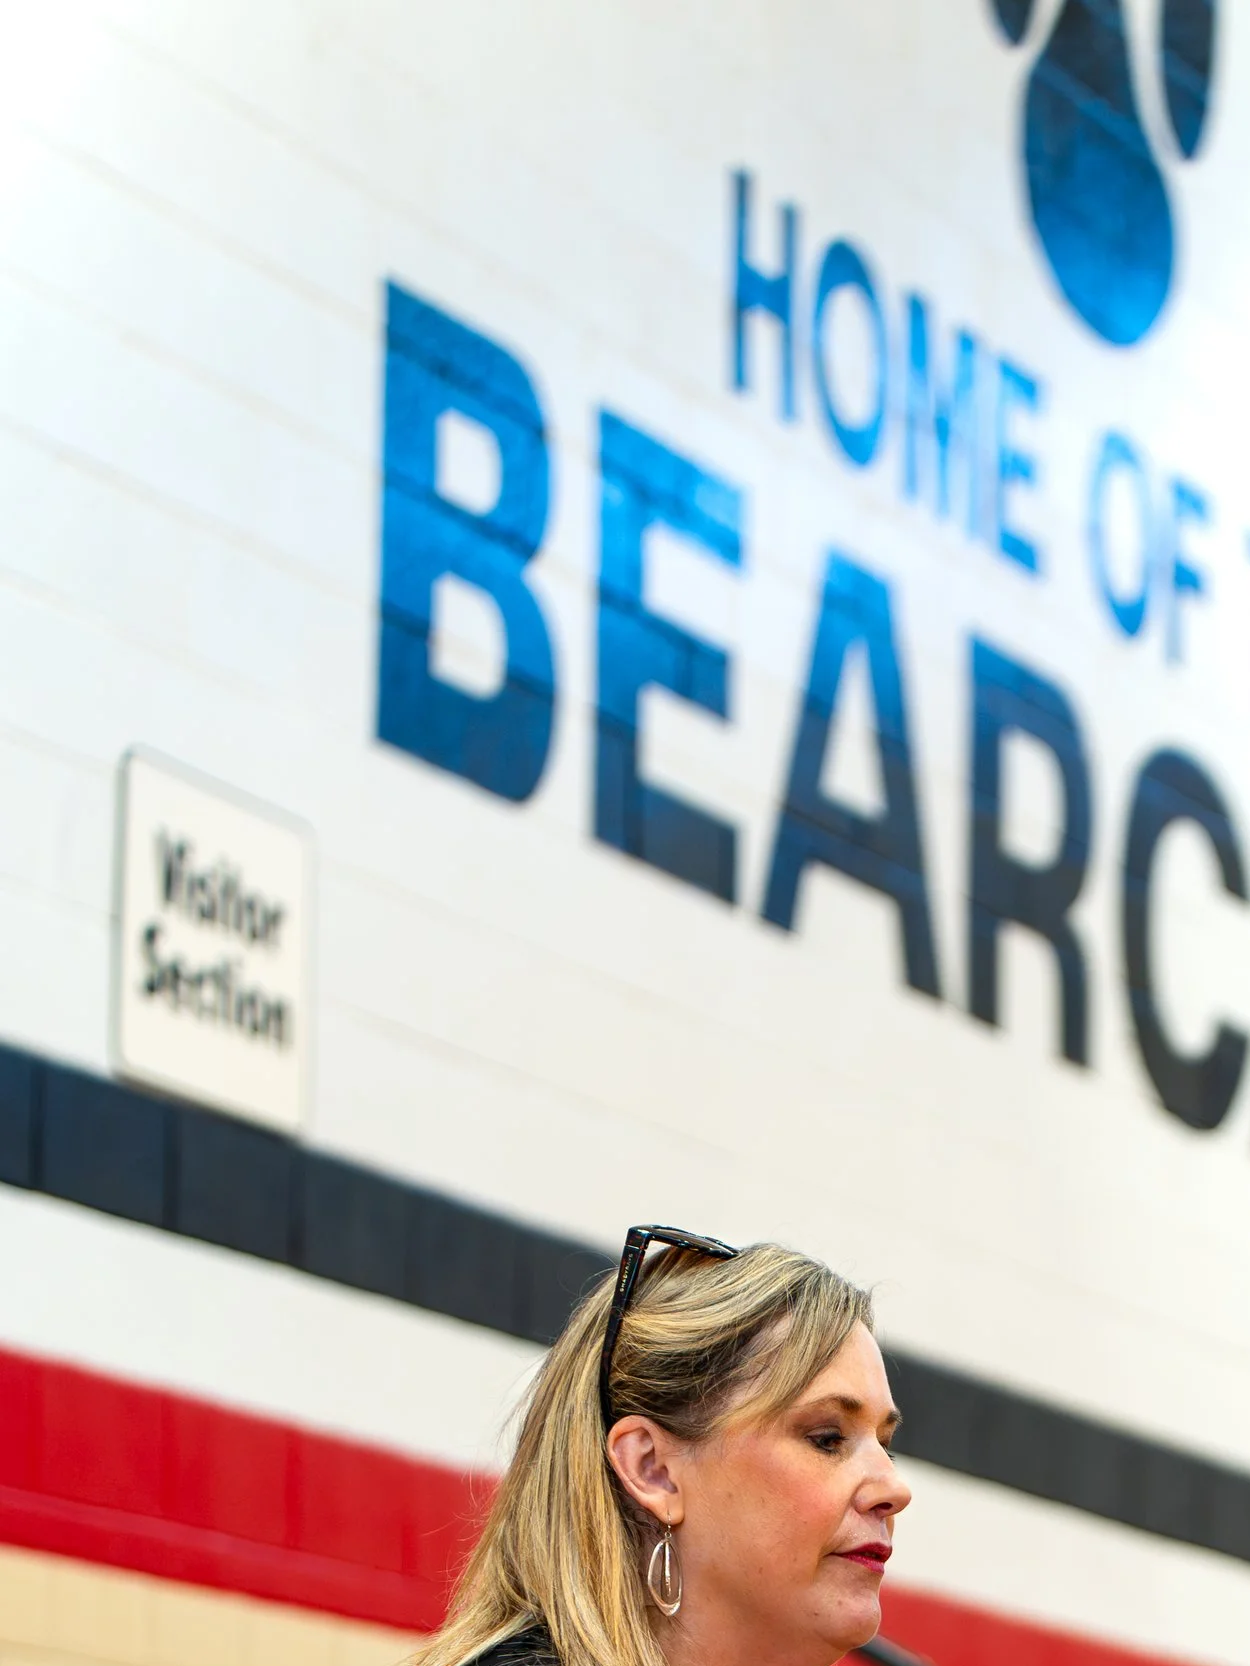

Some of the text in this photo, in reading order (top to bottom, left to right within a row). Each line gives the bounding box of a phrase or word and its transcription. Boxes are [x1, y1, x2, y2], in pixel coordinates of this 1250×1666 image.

[730, 166, 1046, 578] HOME
[1088, 428, 1213, 666] OF
[153, 826, 286, 945] Visitor
